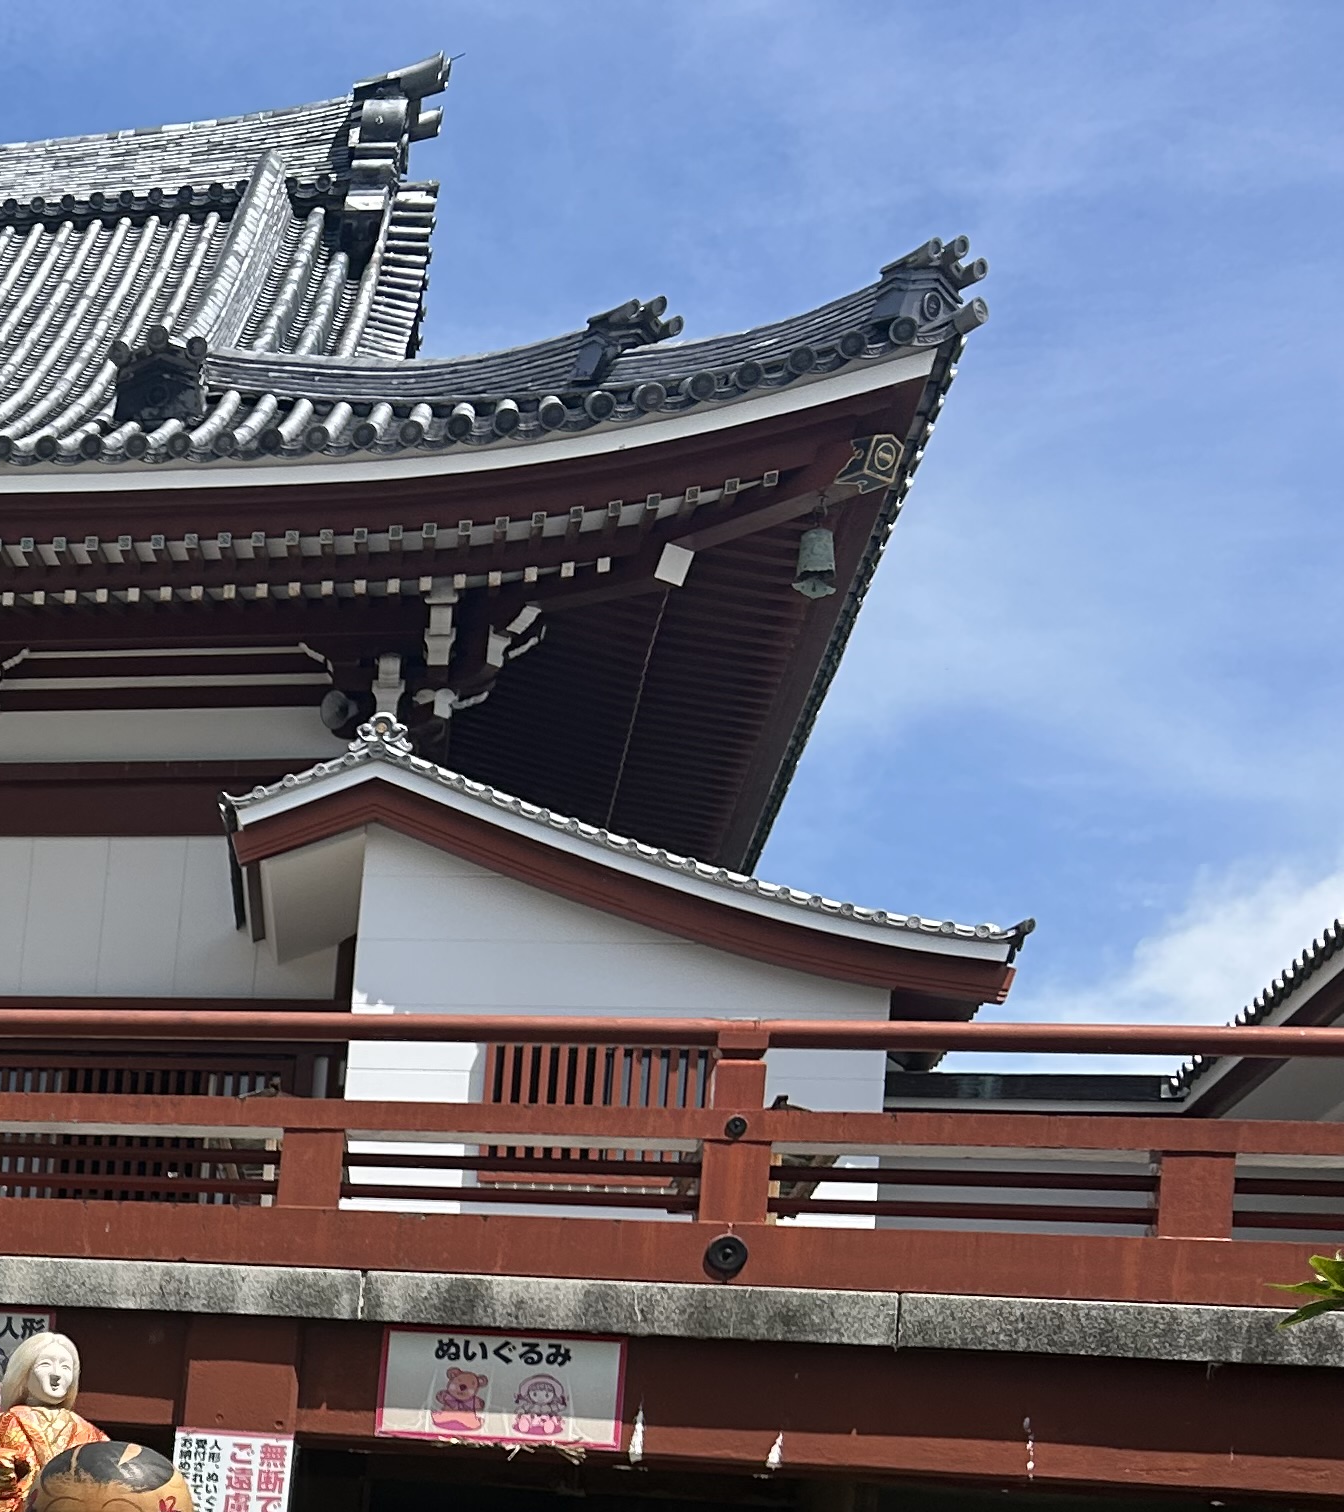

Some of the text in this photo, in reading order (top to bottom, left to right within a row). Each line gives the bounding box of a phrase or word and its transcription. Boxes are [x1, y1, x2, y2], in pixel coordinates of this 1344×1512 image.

[434, 1338, 572, 1367] ぬいぐるみ
